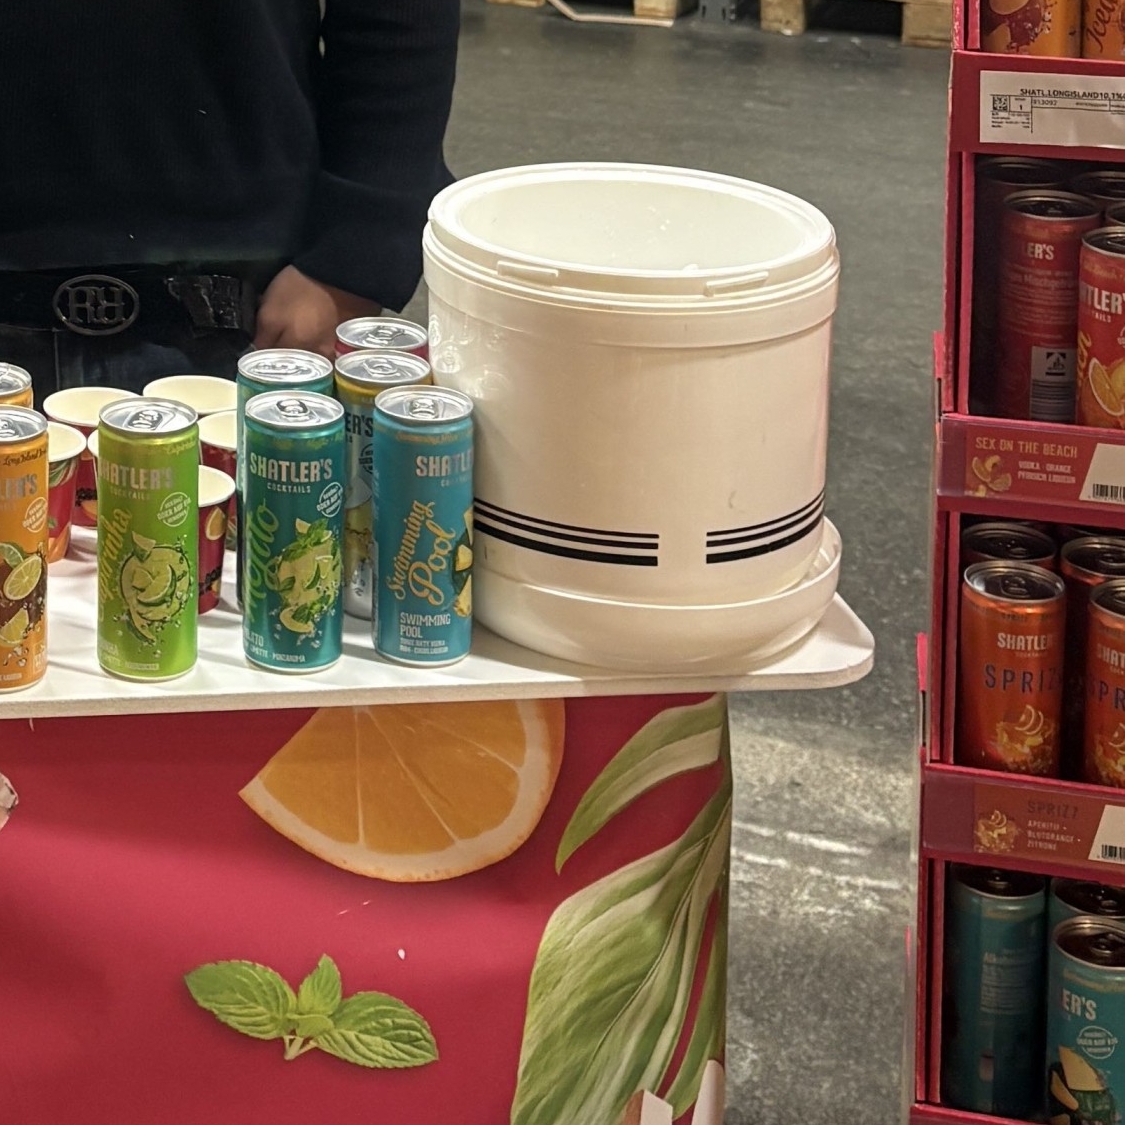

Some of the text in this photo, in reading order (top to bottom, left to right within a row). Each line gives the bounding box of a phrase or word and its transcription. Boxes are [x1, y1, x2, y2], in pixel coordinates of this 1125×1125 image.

[975, 437, 1078, 459] SEX ON THE BEACH
[249, 451, 333, 483] SHATLER'S
[266, 482, 312, 494] COCKTAILS
[384, 499, 436, 601] Swimming
[408, 522, 457, 606] Pool
[400, 612, 451, 626] SWIMMING
[400, 625, 423, 639] POOL
